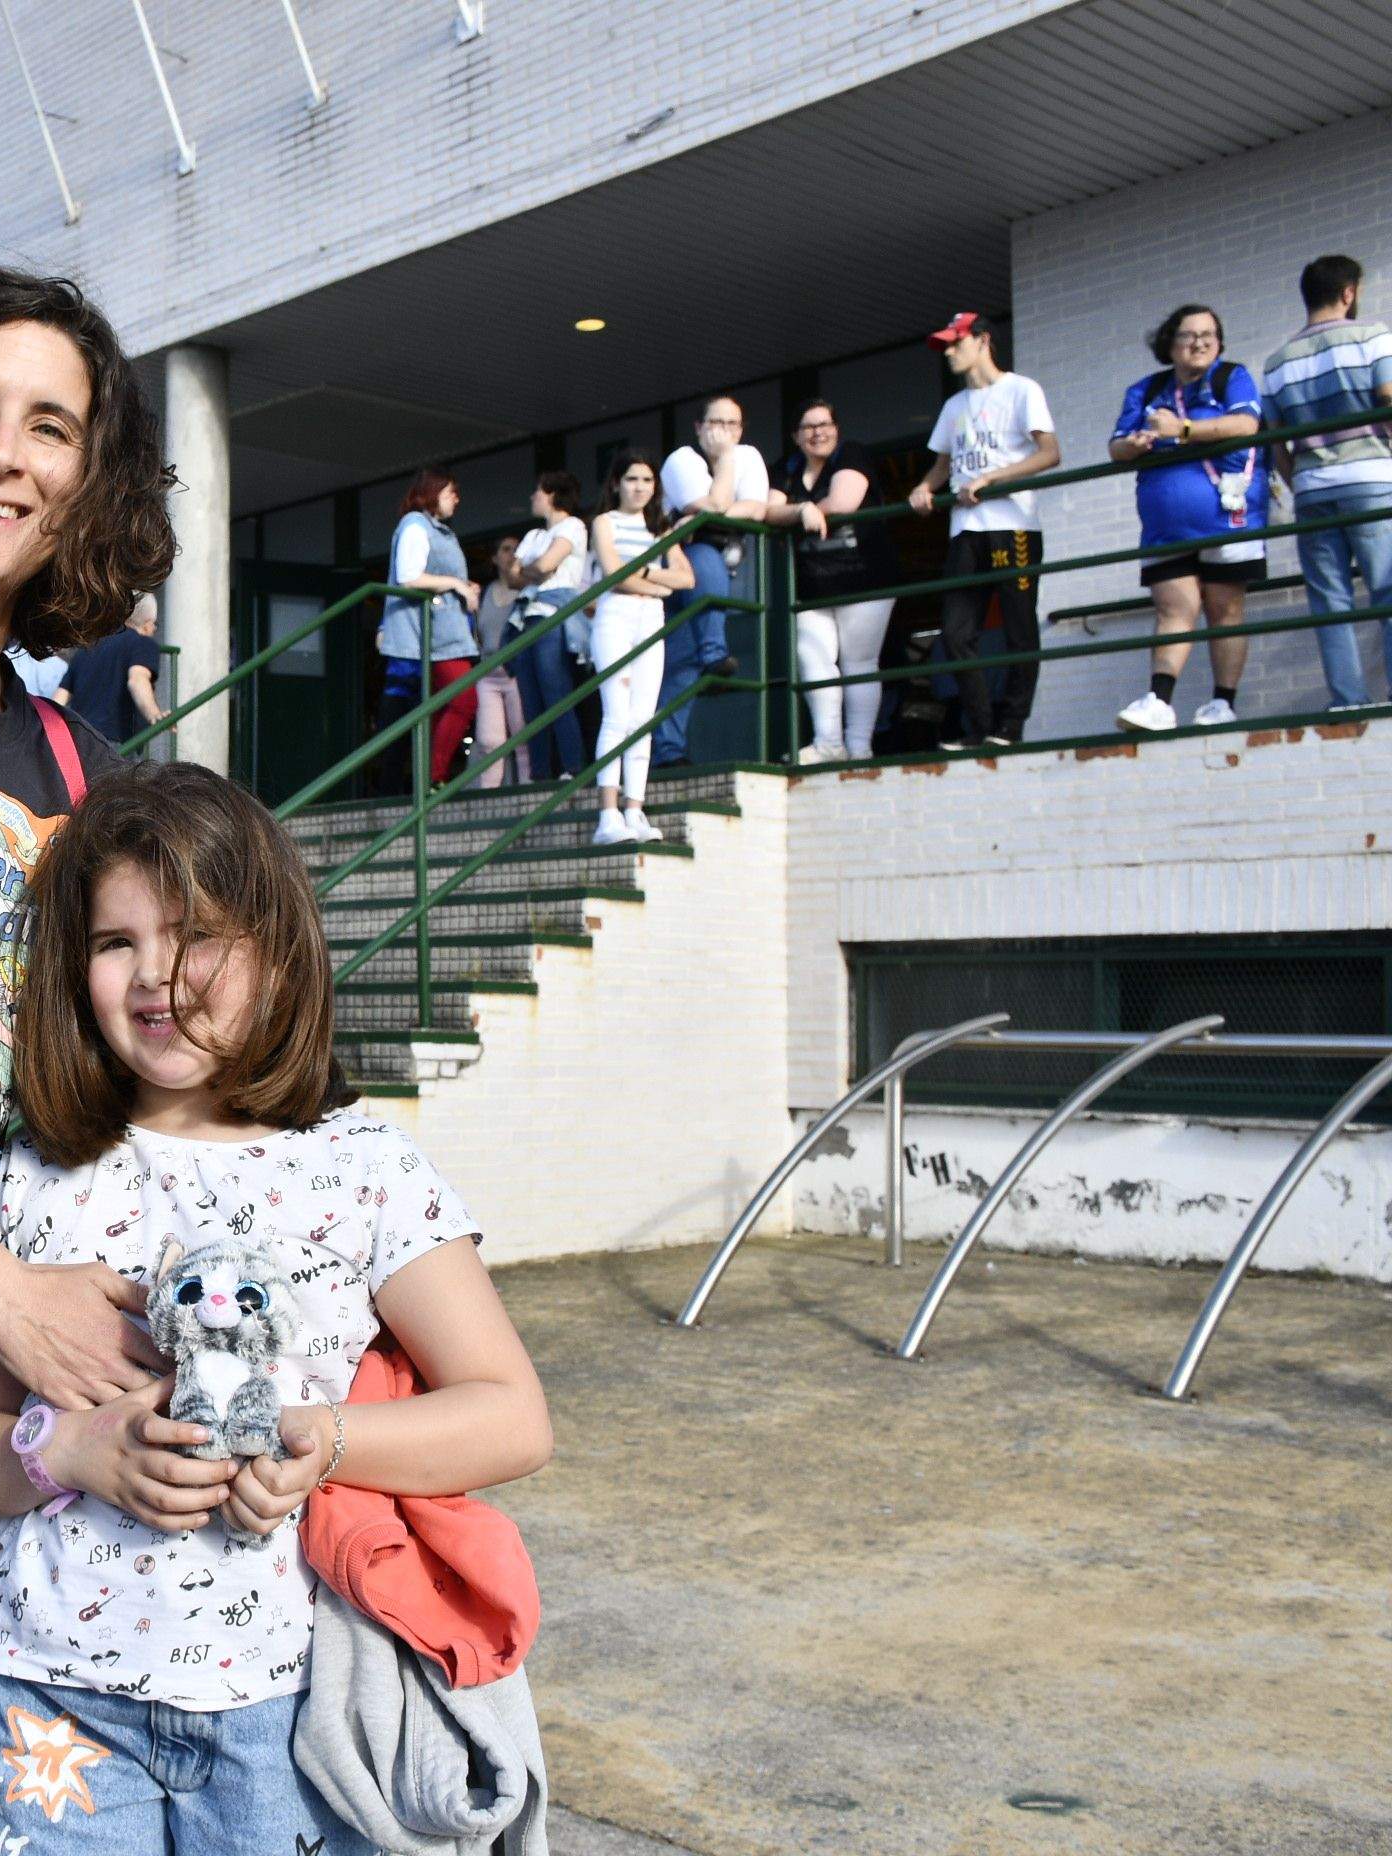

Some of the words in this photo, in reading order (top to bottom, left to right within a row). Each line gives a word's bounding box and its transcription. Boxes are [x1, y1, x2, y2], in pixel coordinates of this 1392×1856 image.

[310, 1175, 342, 1191] BEST
[304, 1335, 339, 1357] BEST
[87, 1542, 122, 1565] BEST
[169, 1644, 213, 1664] BEST
[269, 1651, 310, 1681] LOVE
